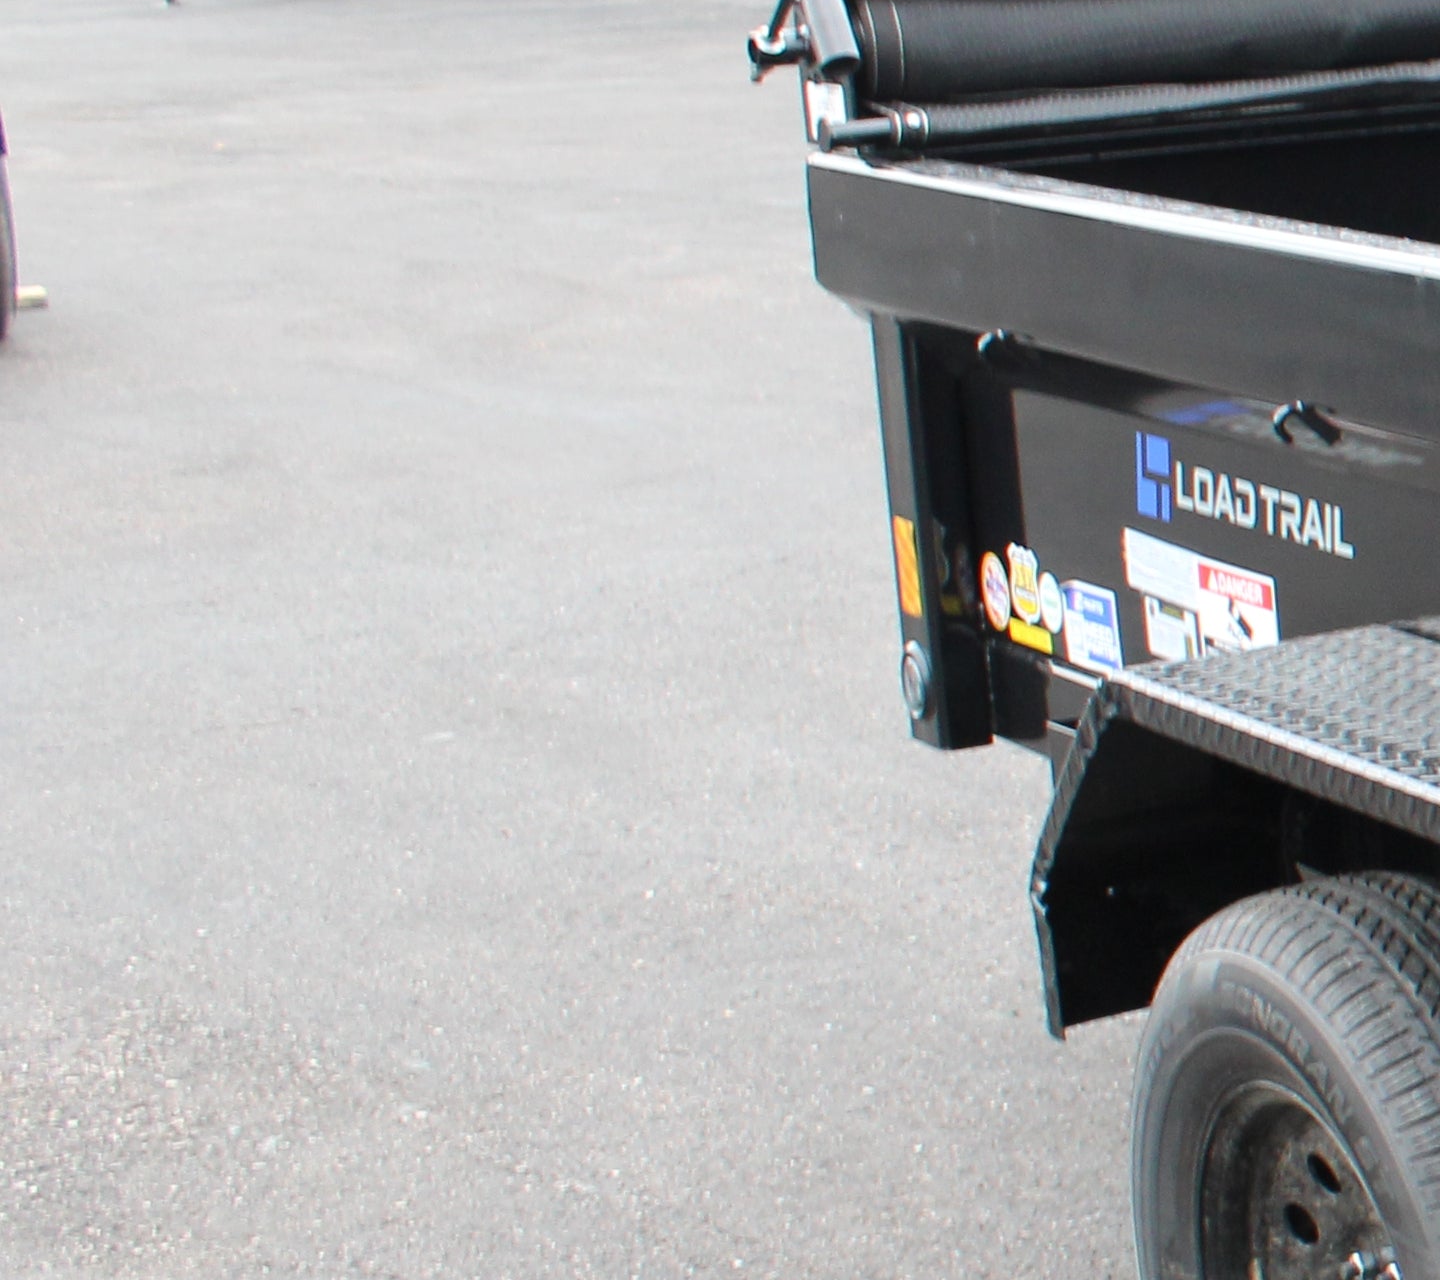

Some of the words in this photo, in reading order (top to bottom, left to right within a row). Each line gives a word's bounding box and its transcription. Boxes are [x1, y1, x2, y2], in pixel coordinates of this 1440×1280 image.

[1174, 460, 1257, 529] LOAD
[1259, 483, 1356, 560] TRAIL
[1218, 572, 1264, 607] DANGER
